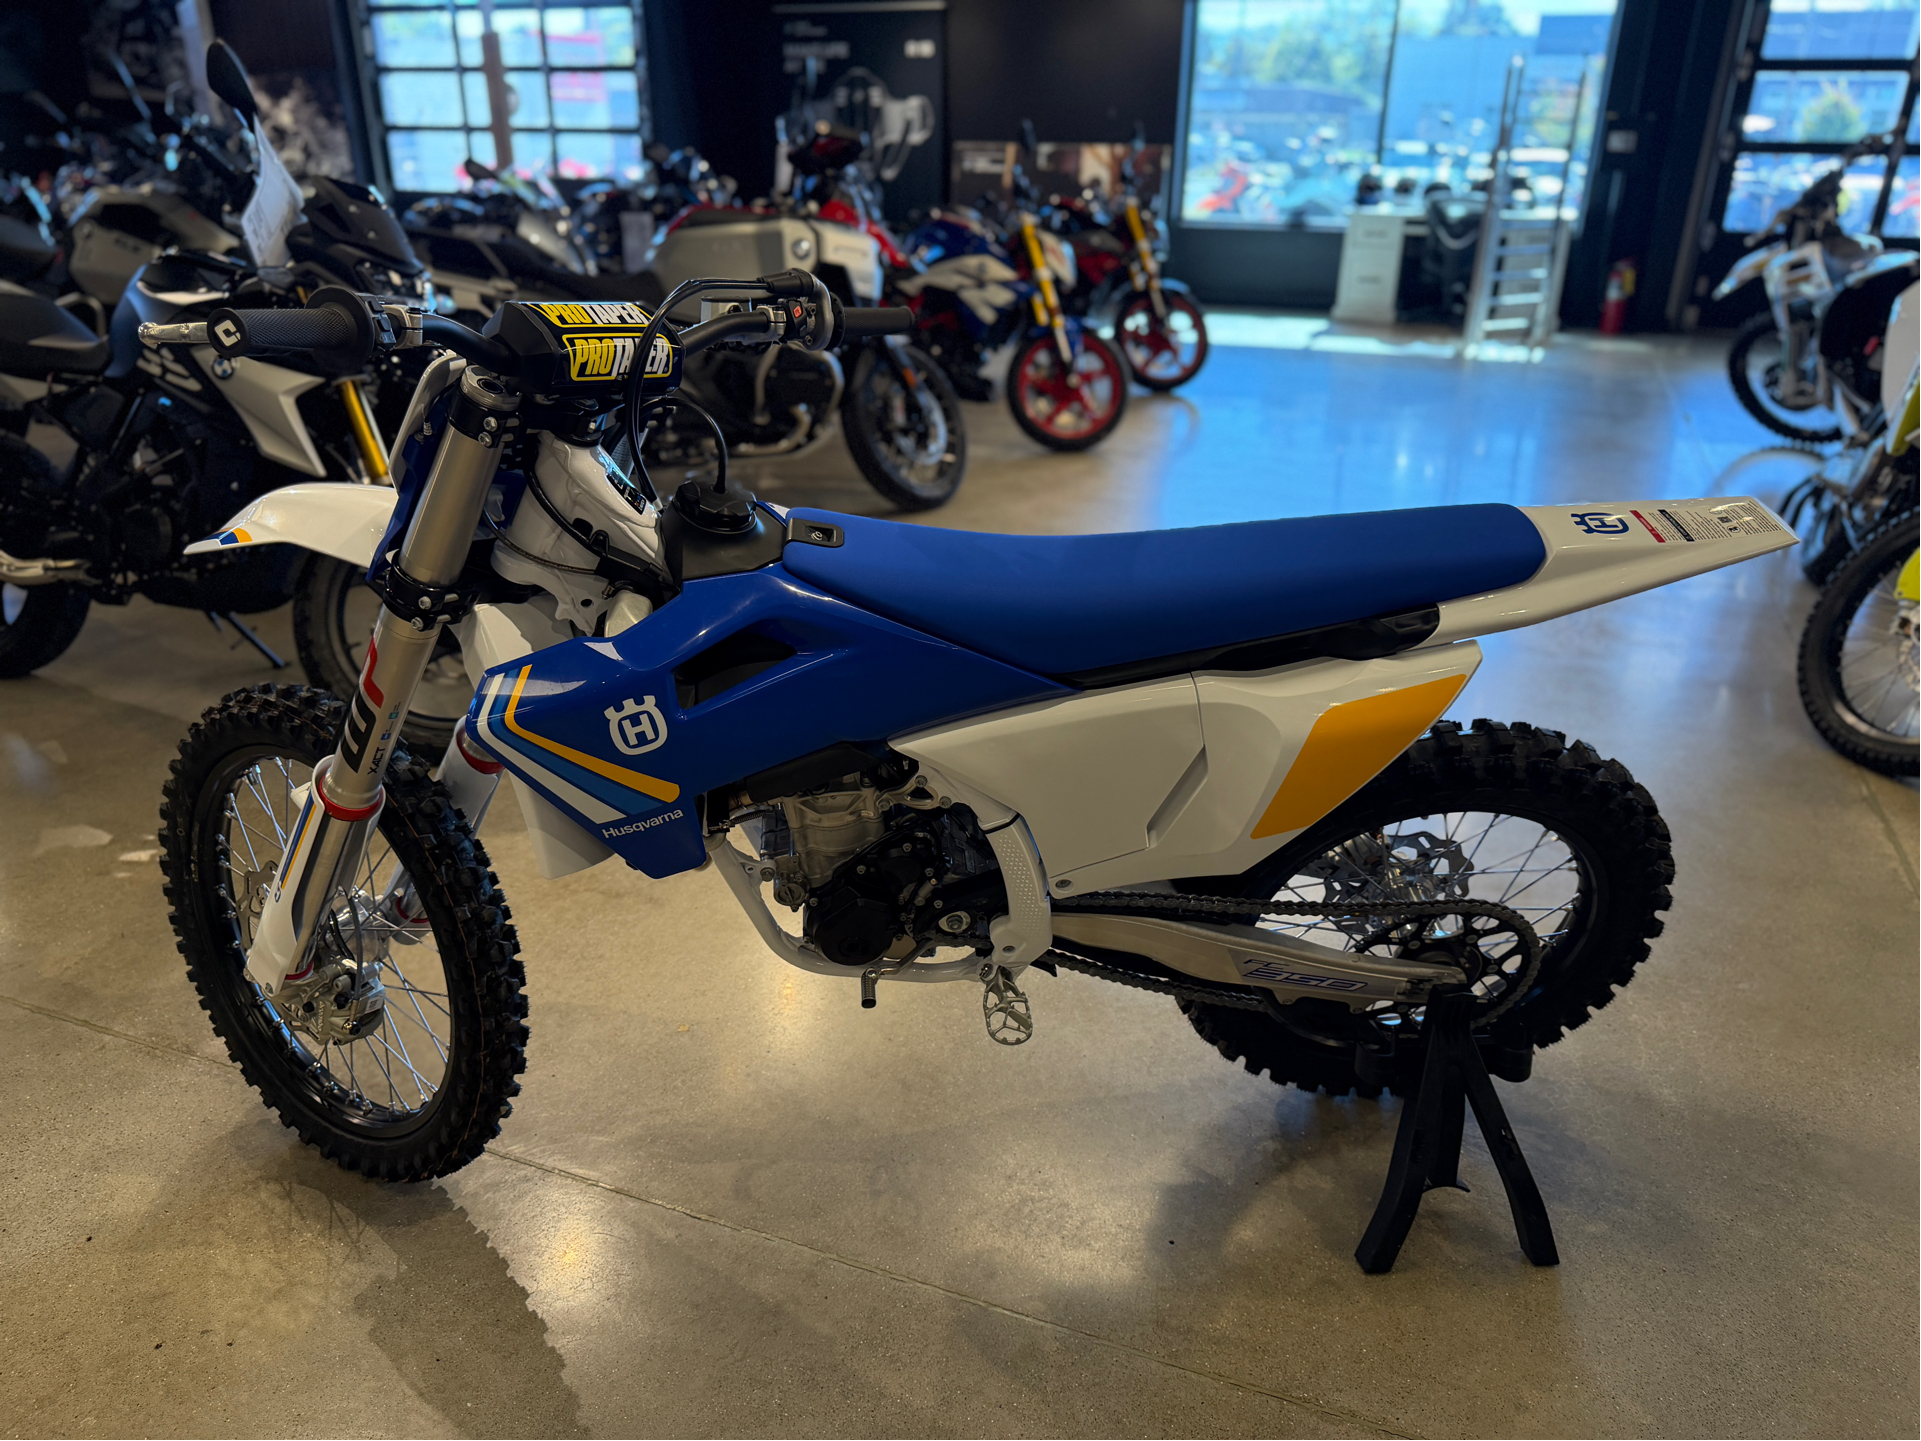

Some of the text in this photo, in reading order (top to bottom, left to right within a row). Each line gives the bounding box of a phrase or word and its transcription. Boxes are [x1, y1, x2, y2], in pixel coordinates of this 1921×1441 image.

[540, 304, 650, 325] PROTAPER
[574, 338, 669, 377] PROTAER
[368, 747, 386, 775] XACT
[602, 809, 684, 839] Husqvarna
[1242, 967, 1368, 991] 350
